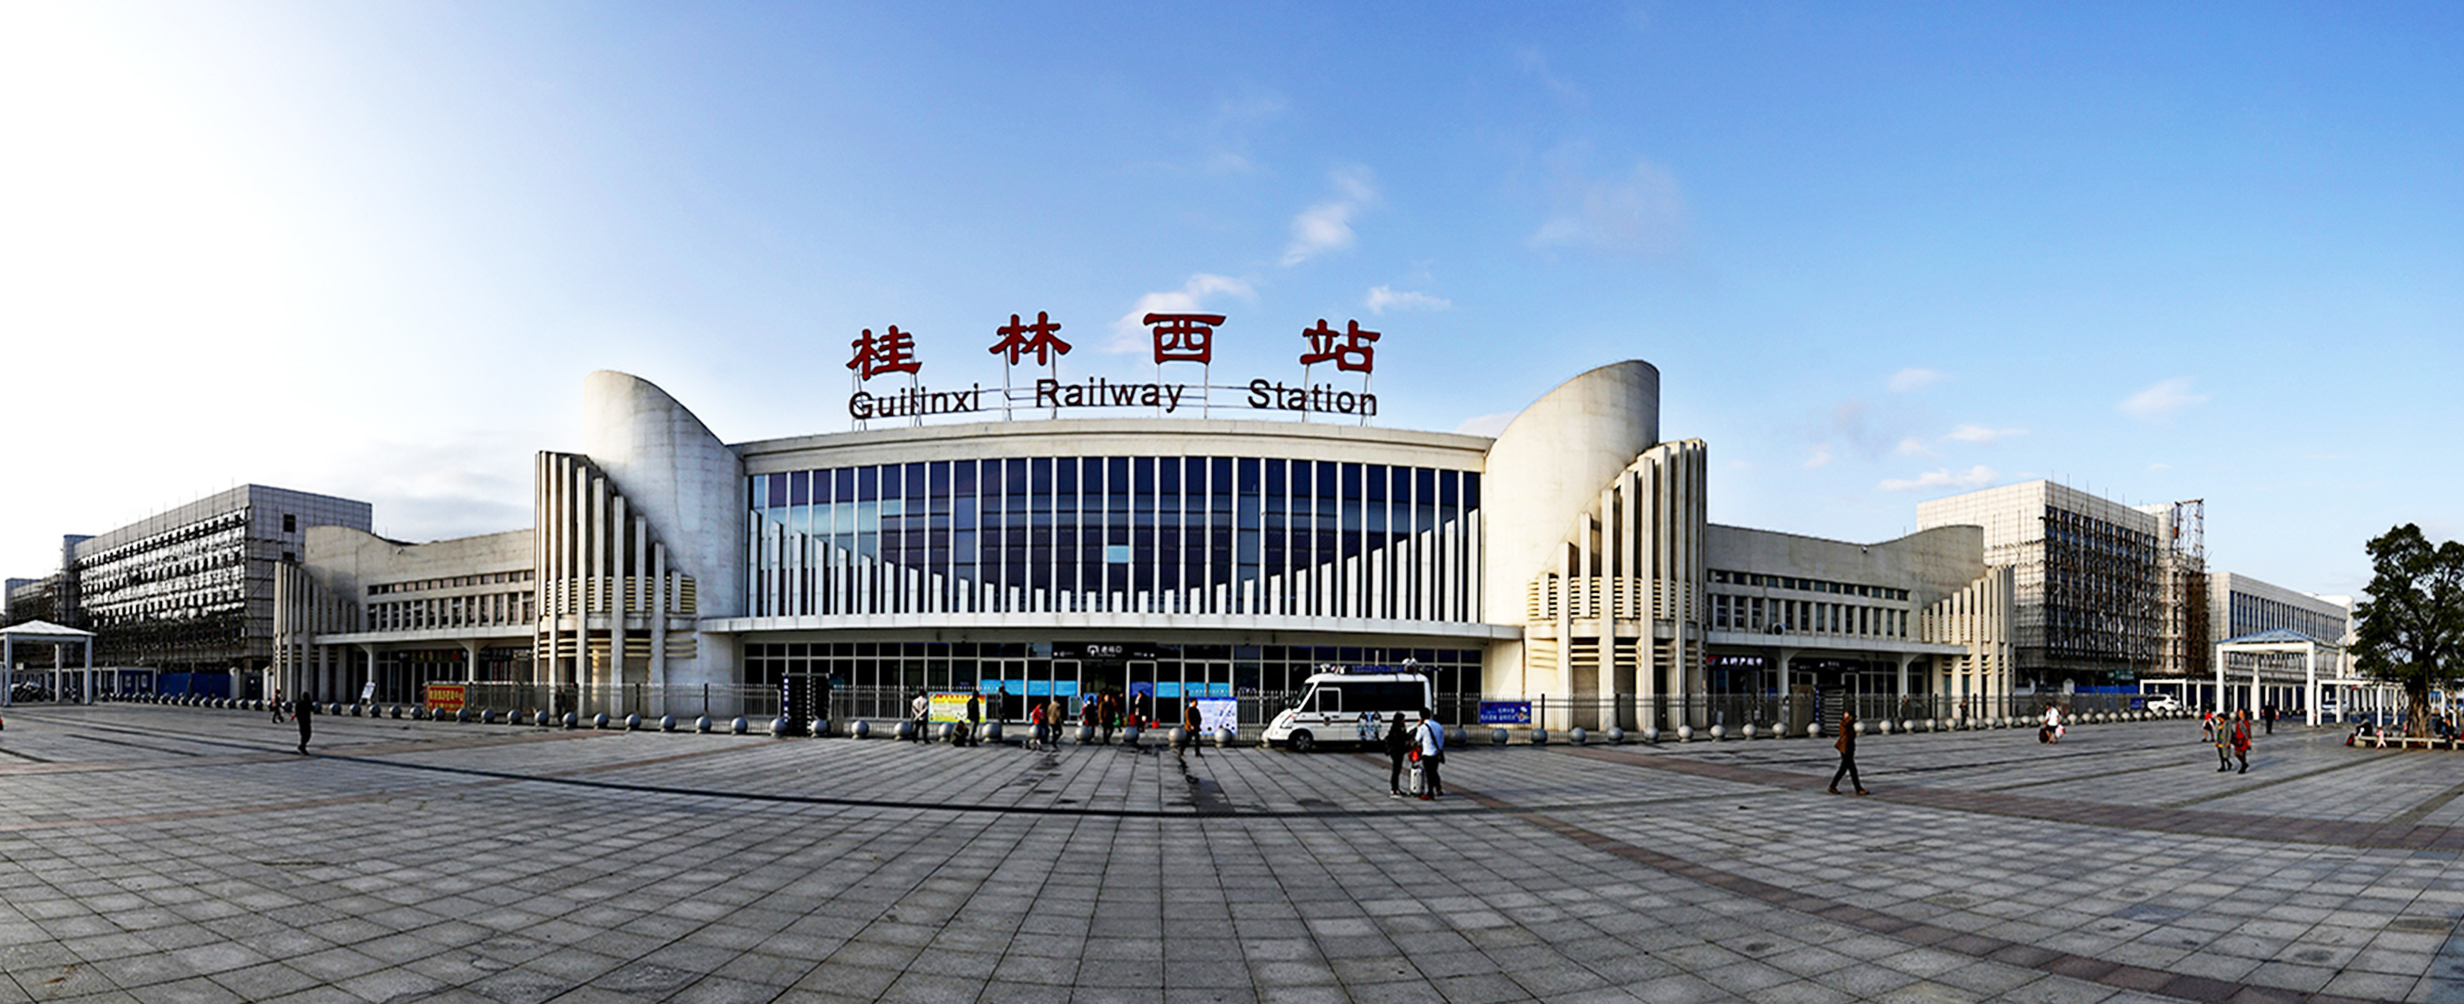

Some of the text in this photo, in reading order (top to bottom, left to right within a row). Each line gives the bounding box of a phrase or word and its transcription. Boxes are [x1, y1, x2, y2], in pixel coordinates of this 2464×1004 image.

[846, 311, 1381, 382] 桂林西站
[849, 376, 1377, 419] Guilinxi Railway Station
